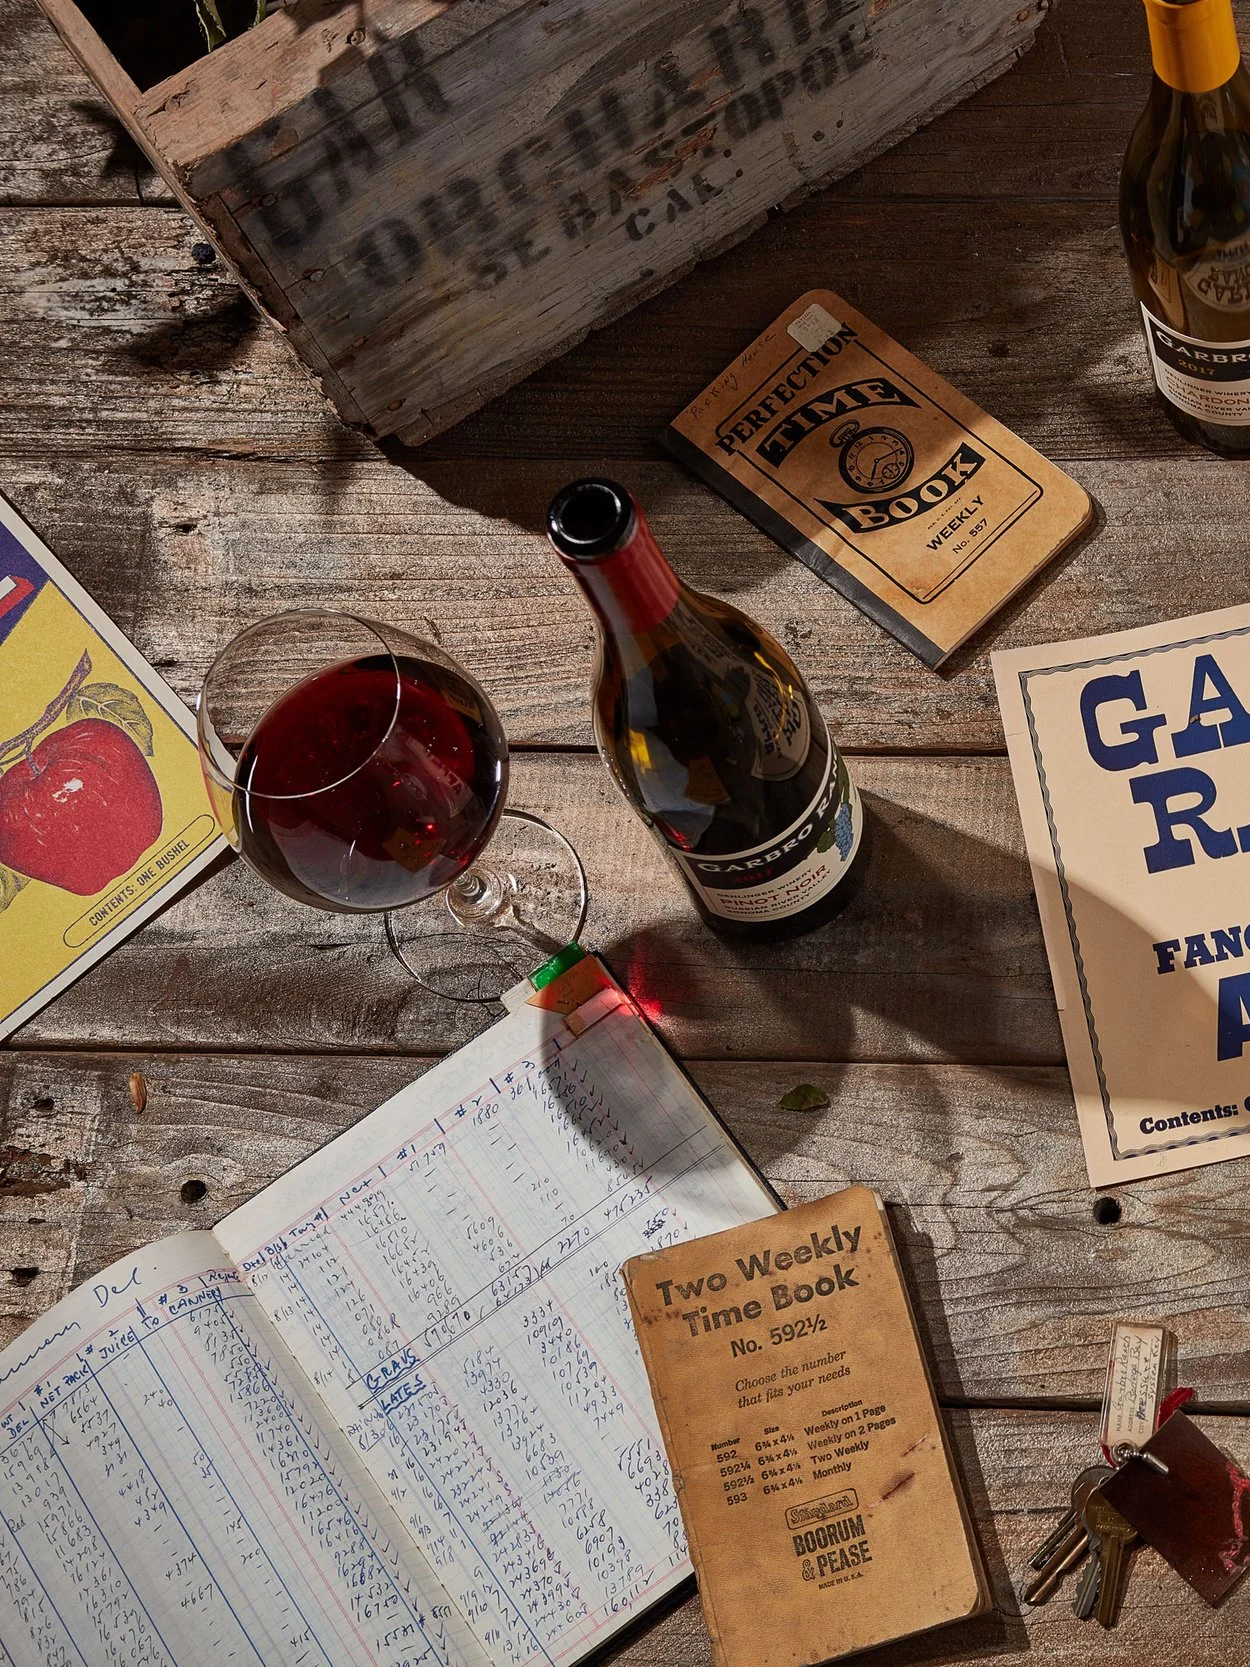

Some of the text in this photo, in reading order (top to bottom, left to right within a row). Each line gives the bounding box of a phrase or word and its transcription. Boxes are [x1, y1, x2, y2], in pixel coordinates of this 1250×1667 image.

[715, 321, 859, 456] PERFECTION
[1178, 360, 1216, 376] 2017
[764, 381, 901, 453] TIME
[1205, 403, 1232, 411] RIVER
[1205, 409, 1243, 417] COUNTY
[842, 453, 978, 529] BOOK
[926, 495, 984, 551] WEEKLY
[952, 518, 989, 554] No. 557
[698, 823, 814, 872] GARBRO
[89, 839, 190, 927] CONTENTS: ONE BUSHEL
[720, 865, 828, 906] PINOT NOIR
[770, 893, 799, 907] RIVER
[801, 870, 831, 894] VALLEY
[777, 868, 812, 890] WINERY
[772, 892, 810, 911] COUNTY
[1139, 1102, 1239, 1136] Contents:
[656, 1224, 862, 1306] Two Weekly
[169, 1286, 223, 1315] CANNERY
[682, 1263, 860, 1337] Time Book
[730, 1338, 763, 1357] No.
[735, 1350, 847, 1393] Choose the number
[738, 1365, 851, 1409] that fits your needs
[40, 1387, 62, 1409] NET
[711, 1399, 863, 1451] Number Size Description
[716, 1450, 739, 1464] 592
[803, 1419, 840, 1437] Weekly
[841, 1415, 854, 1425] on
[855, 1411, 861, 1421] 1
[862, 1404, 886, 1421] Page
[806, 1433, 843, 1451] Weekly
[844, 1429, 857, 1440] on
[858, 1424, 866, 1435] 2
[867, 1416, 897, 1435] Pages
[810, 1452, 832, 1465] Two
[834, 1439, 870, 1458] Weekly
[726, 1492, 749, 1506] 593
[812, 1461, 852, 1481] Monthly
[790, 1494, 855, 1525] Standard
[792, 1514, 866, 1557] BOORUM
[802, 1539, 872, 1582] & PEASE
[818, 1579, 836, 1591] MADE
